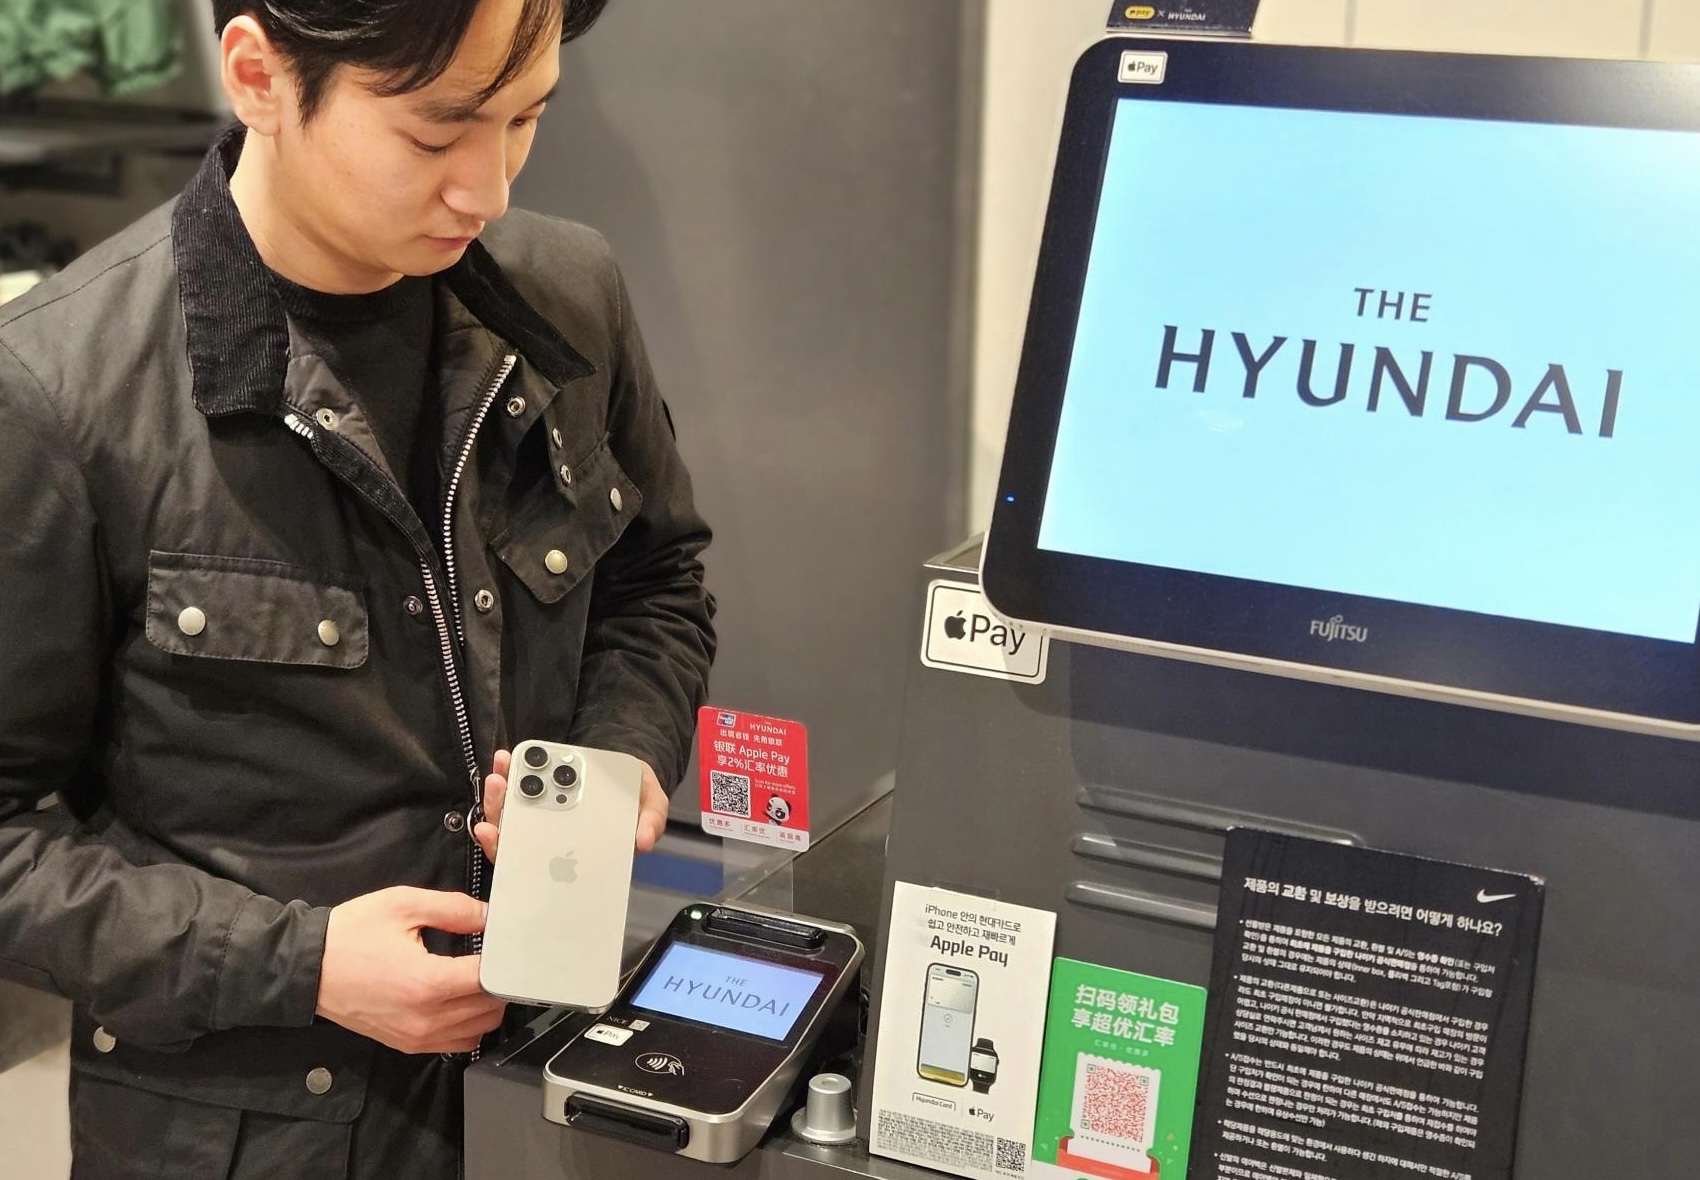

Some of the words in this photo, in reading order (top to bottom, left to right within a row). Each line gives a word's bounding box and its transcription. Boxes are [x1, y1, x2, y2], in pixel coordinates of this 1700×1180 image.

[1168, 12, 1206, 21] HYUNDAI
[1136, 61, 1158, 75] Pay
[1354, 287, 1433, 322] THE
[1155, 324, 1624, 439] HYUNDAI
[970, 614, 1026, 655] Pay
[1309, 614, 1368, 642] FUJITSU
[750, 723, 787, 735] HYUNDAI
[713, 740, 736, 754] 银联
[739, 745, 768, 760] Apple
[771, 751, 790, 766] Pay
[717, 755, 788, 778] 享2%汇率优惠
[925, 904, 958, 919] iPhone
[960, 911, 977, 924] 안의
[979, 915, 1022, 933] 현대카드로
[1244, 877, 1279, 895] 제품의
[1282, 885, 1307, 900] 교환
[1310, 889, 1321, 903] 및
[1324, 892, 1360, 910] 보상을
[1365, 899, 1412, 920] 받으려면
[1416, 909, 1453, 927] 어떻게
[1457, 916, 1502, 936] 하나요?
[928, 918, 944, 930] 쉽고
[946, 922, 980, 938] 안전하고
[982, 928, 1016, 946] 재빠르게
[930, 935, 974, 956] Apple
[978, 945, 1009, 968] Pay
[1355, 952, 1375, 963] 나이키
[725, 976, 748, 987] THE
[663, 975, 790, 1017] HYUNDAI
[1075, 983, 1180, 1025] 扫码领礼包
[1378, 1003, 1399, 1013] 나이키
[1071, 1007, 1176, 1047] 享超优汇率
[1260, 1003, 1279, 1012] 나이키
[1449, 1041, 1470, 1051] 나이키
[1353, 1079, 1373, 1090] 나이키
[977, 1108, 995, 1123] Pay
